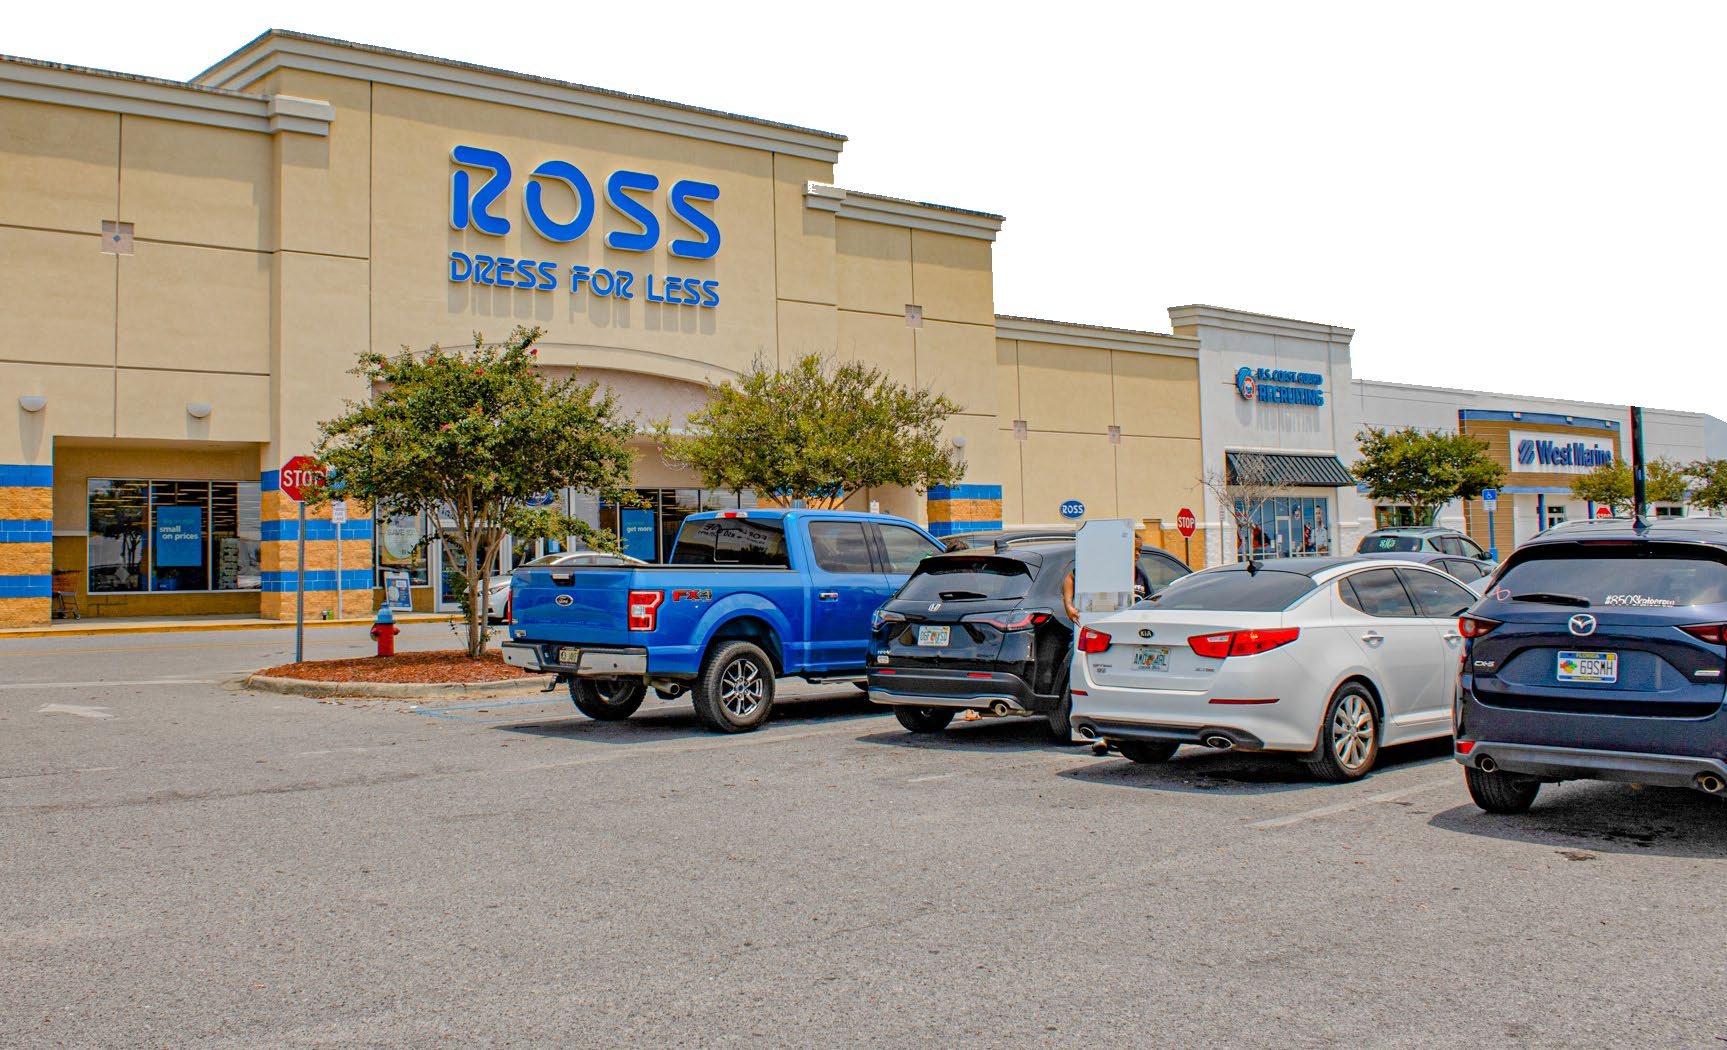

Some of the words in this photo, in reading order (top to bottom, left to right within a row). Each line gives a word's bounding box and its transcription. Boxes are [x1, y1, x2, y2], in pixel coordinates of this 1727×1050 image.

[451, 145, 721, 259] ROSS
[449, 251, 558, 291] DRESS
[569, 265, 635, 299] FOR
[647, 273, 720, 307] LESS
[1257, 383, 1325, 407] RECRUITING
[1536, 440, 1573, 466] West
[1573, 443, 1612, 468] Marine
[1062, 504, 1084, 514] ROSS
[1177, 516, 1195, 528] STOP
[159, 525, 181, 533] small
[627, 524, 637, 533] get
[174, 532, 199, 541] prices
[672, 589, 712, 602] FX4
[1140, 629, 1152, 637] KIA
